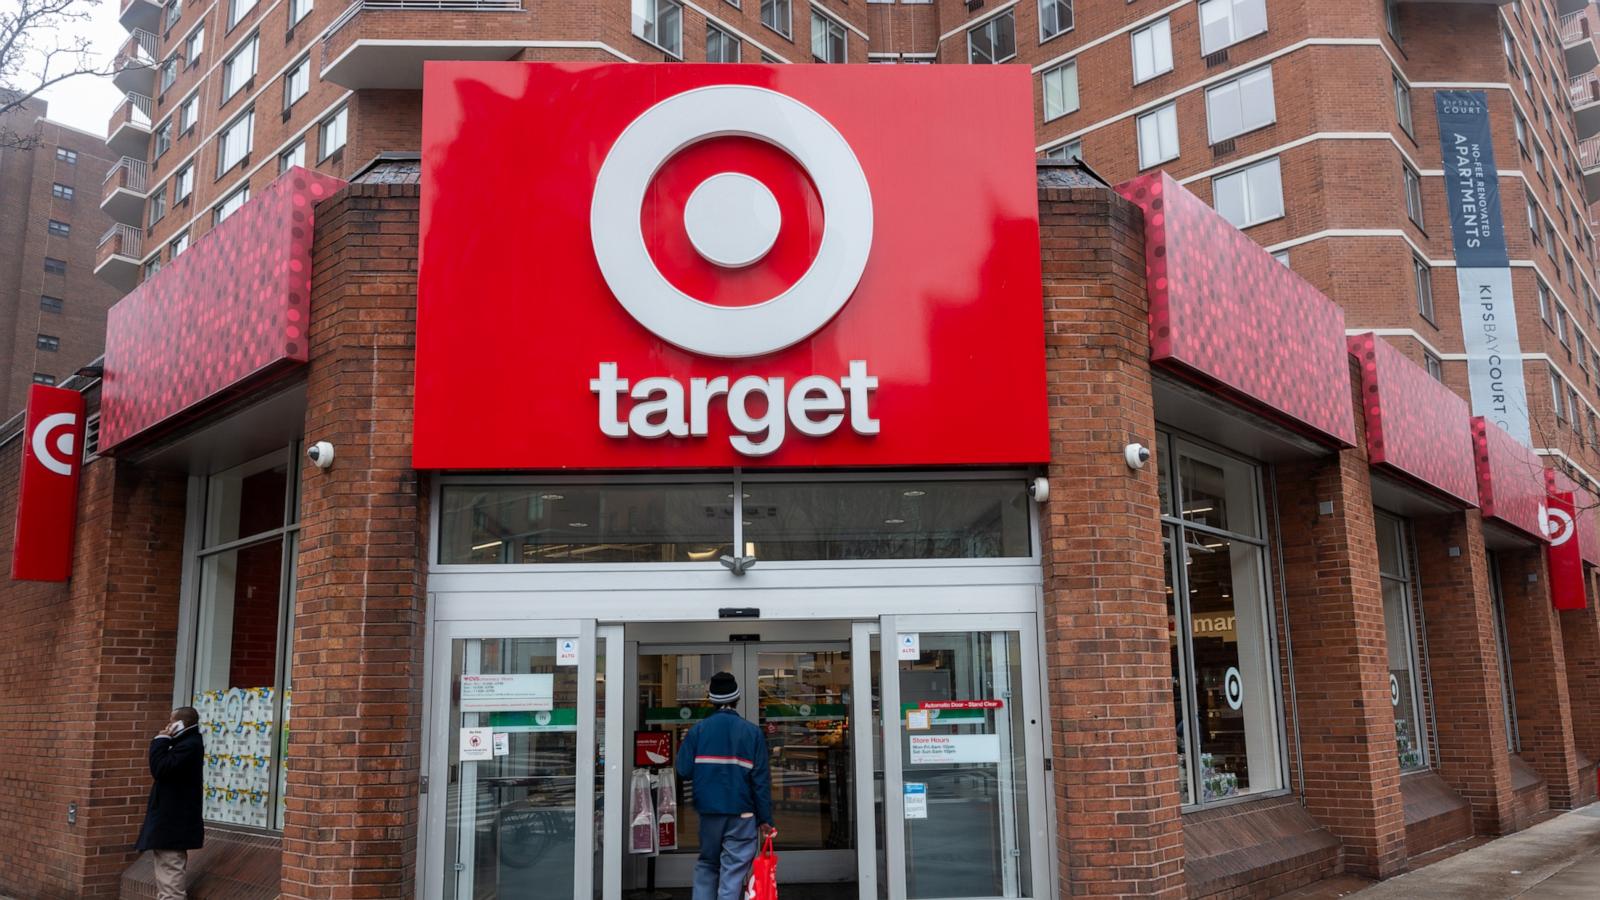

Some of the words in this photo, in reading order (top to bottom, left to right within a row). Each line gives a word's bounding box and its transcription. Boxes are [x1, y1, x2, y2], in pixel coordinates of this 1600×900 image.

[1443, 106, 1481, 114] COURT
[1471, 144, 1484, 178] NO-FEE
[1454, 133, 1480, 248] APARTMENTS
[1477, 181, 1491, 237] RENOVATED
[590, 360, 881, 458] target
